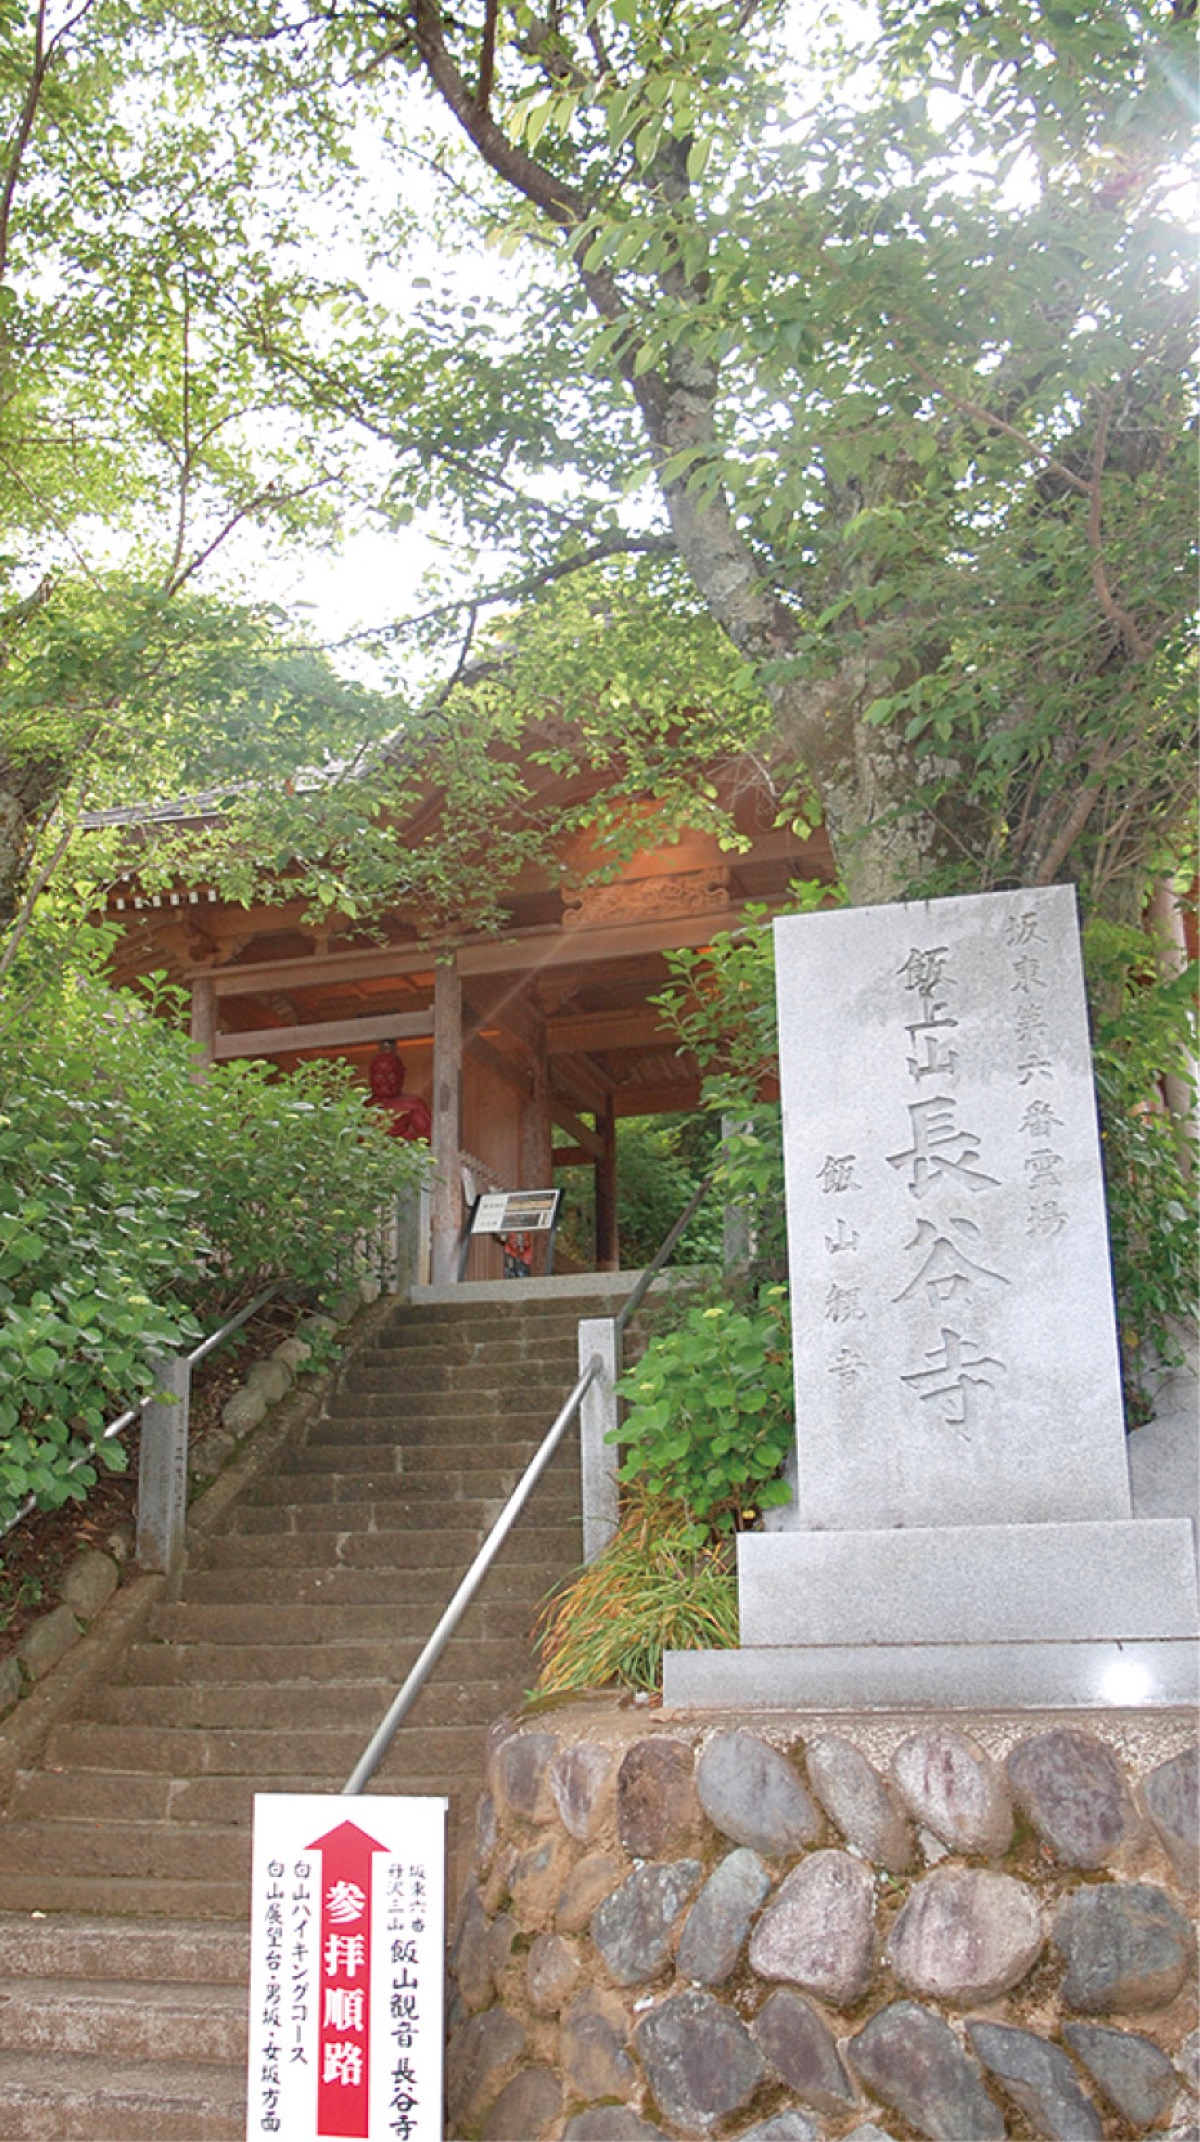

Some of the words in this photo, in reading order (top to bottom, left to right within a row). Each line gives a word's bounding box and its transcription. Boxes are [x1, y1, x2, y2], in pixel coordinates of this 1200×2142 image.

[815, 1154, 869, 1390] 飯山観音
[885, 945, 1011, 1441] 飯上山長谷寺
[289, 1859, 312, 2065] 白山ハイキングコース
[321, 1879, 366, 2087] 参拝順路
[389, 1938, 420, 2049] 飯山観音
[388, 2056, 420, 2141] 長谷寺
